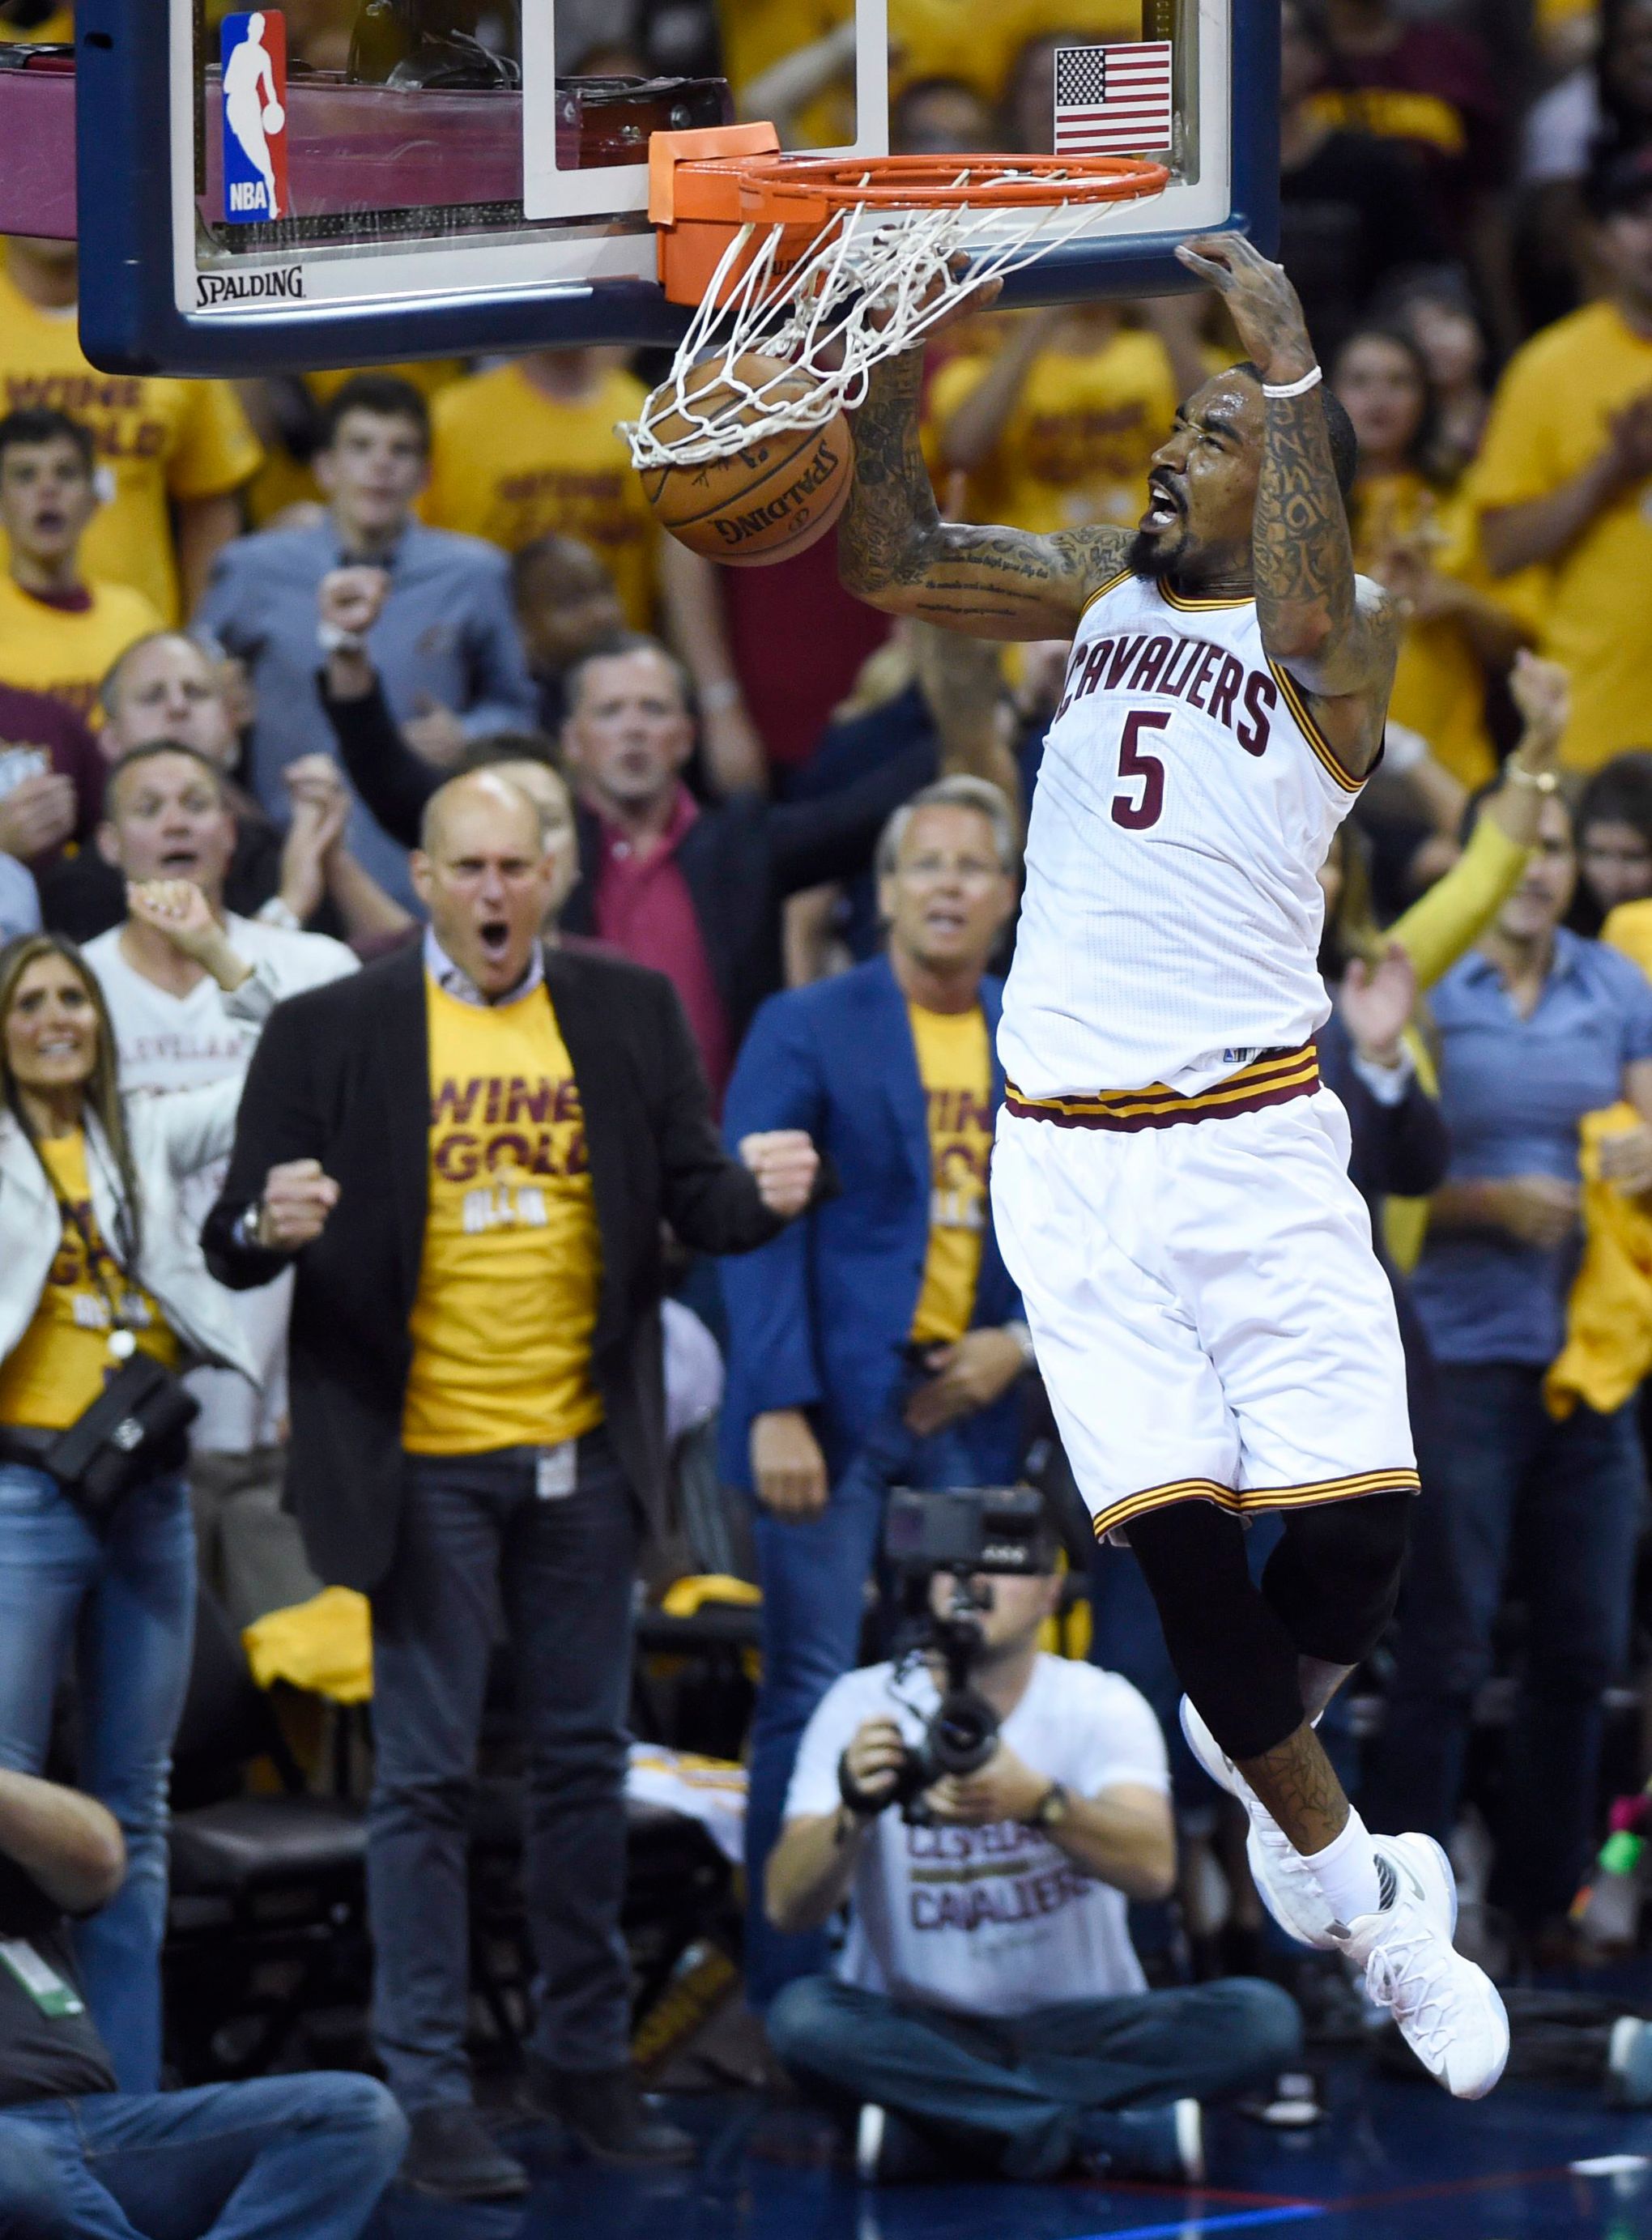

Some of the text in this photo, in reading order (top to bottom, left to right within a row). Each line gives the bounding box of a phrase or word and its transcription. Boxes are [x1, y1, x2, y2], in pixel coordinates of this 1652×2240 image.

[230, 181, 267, 211] NBA
[197, 265, 303, 308] SPALDING
[710, 438, 839, 544] SPALDING
[1054, 635, 1277, 757] CAVALIERS
[1111, 710, 1172, 830] 5
